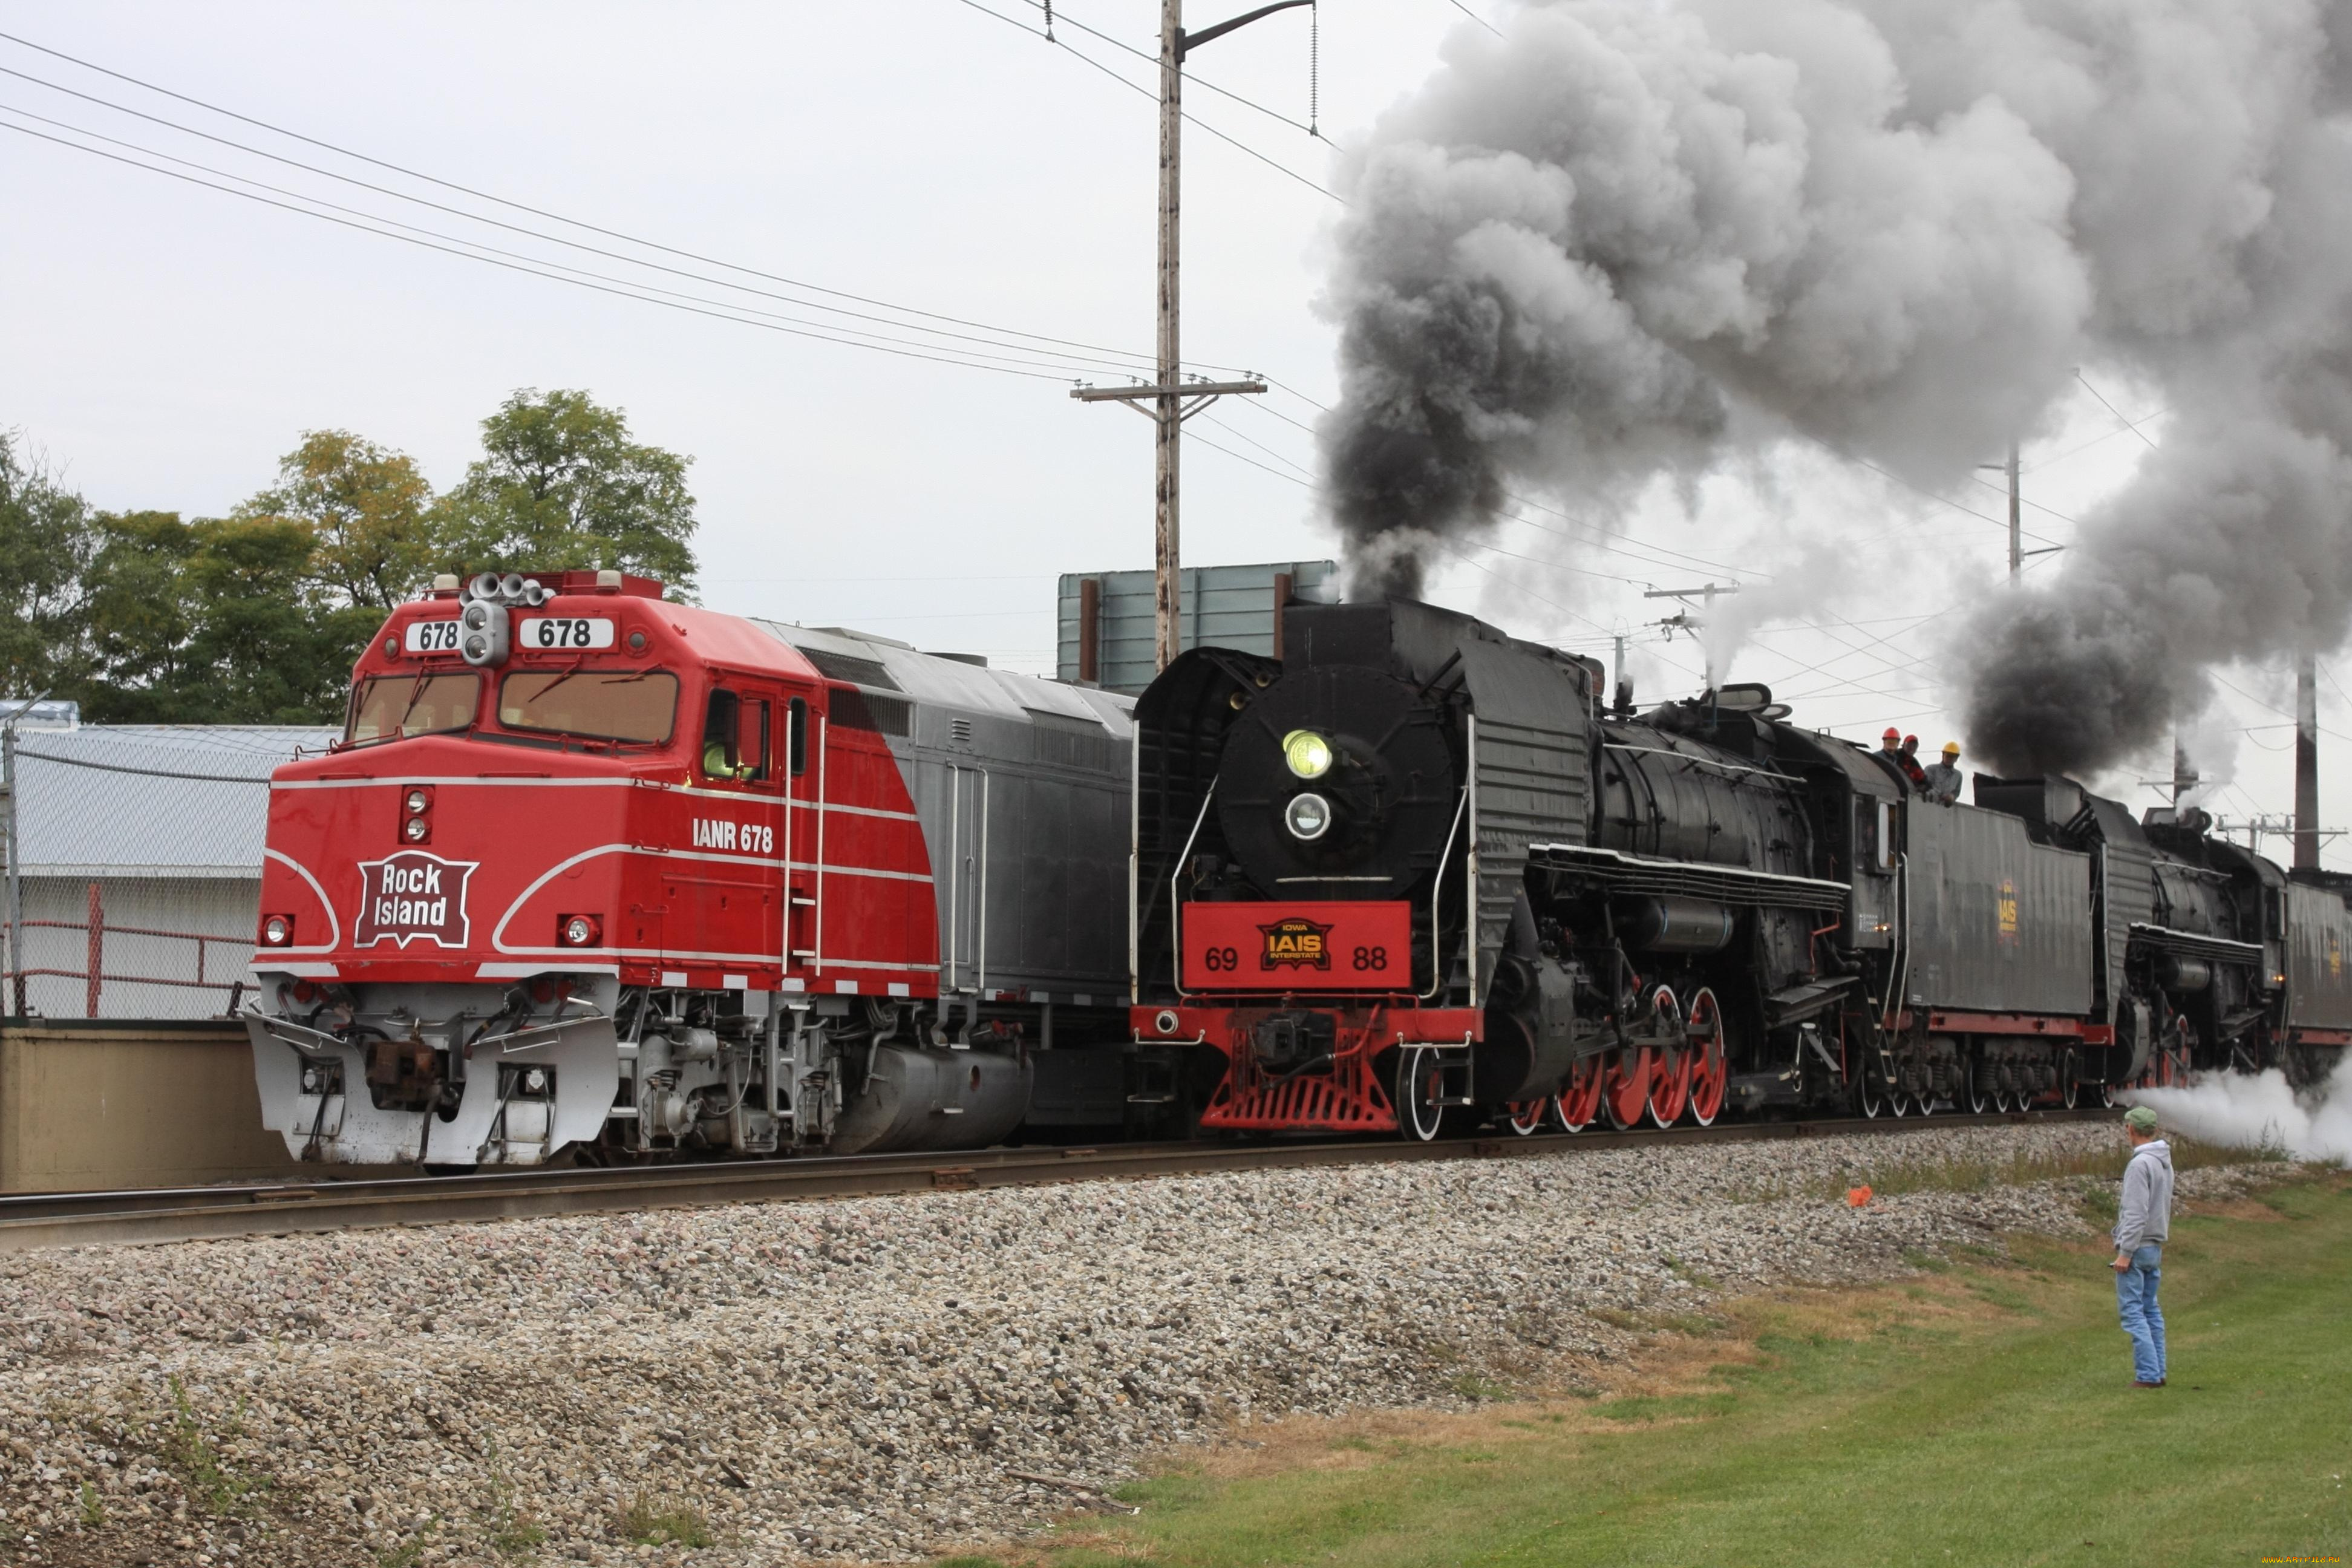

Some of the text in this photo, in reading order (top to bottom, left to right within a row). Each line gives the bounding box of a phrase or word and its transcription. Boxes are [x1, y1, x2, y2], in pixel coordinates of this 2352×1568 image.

[420, 622, 457, 650] 678
[538, 619, 591, 647] 678
[693, 818, 773, 854] IANR 678
[382, 864, 442, 894] Rock
[374, 896, 446, 926] Island
[1269, 935, 1321, 952] IAIS
[1206, 948, 1238, 971] 69
[1353, 947, 1387, 970] 88
